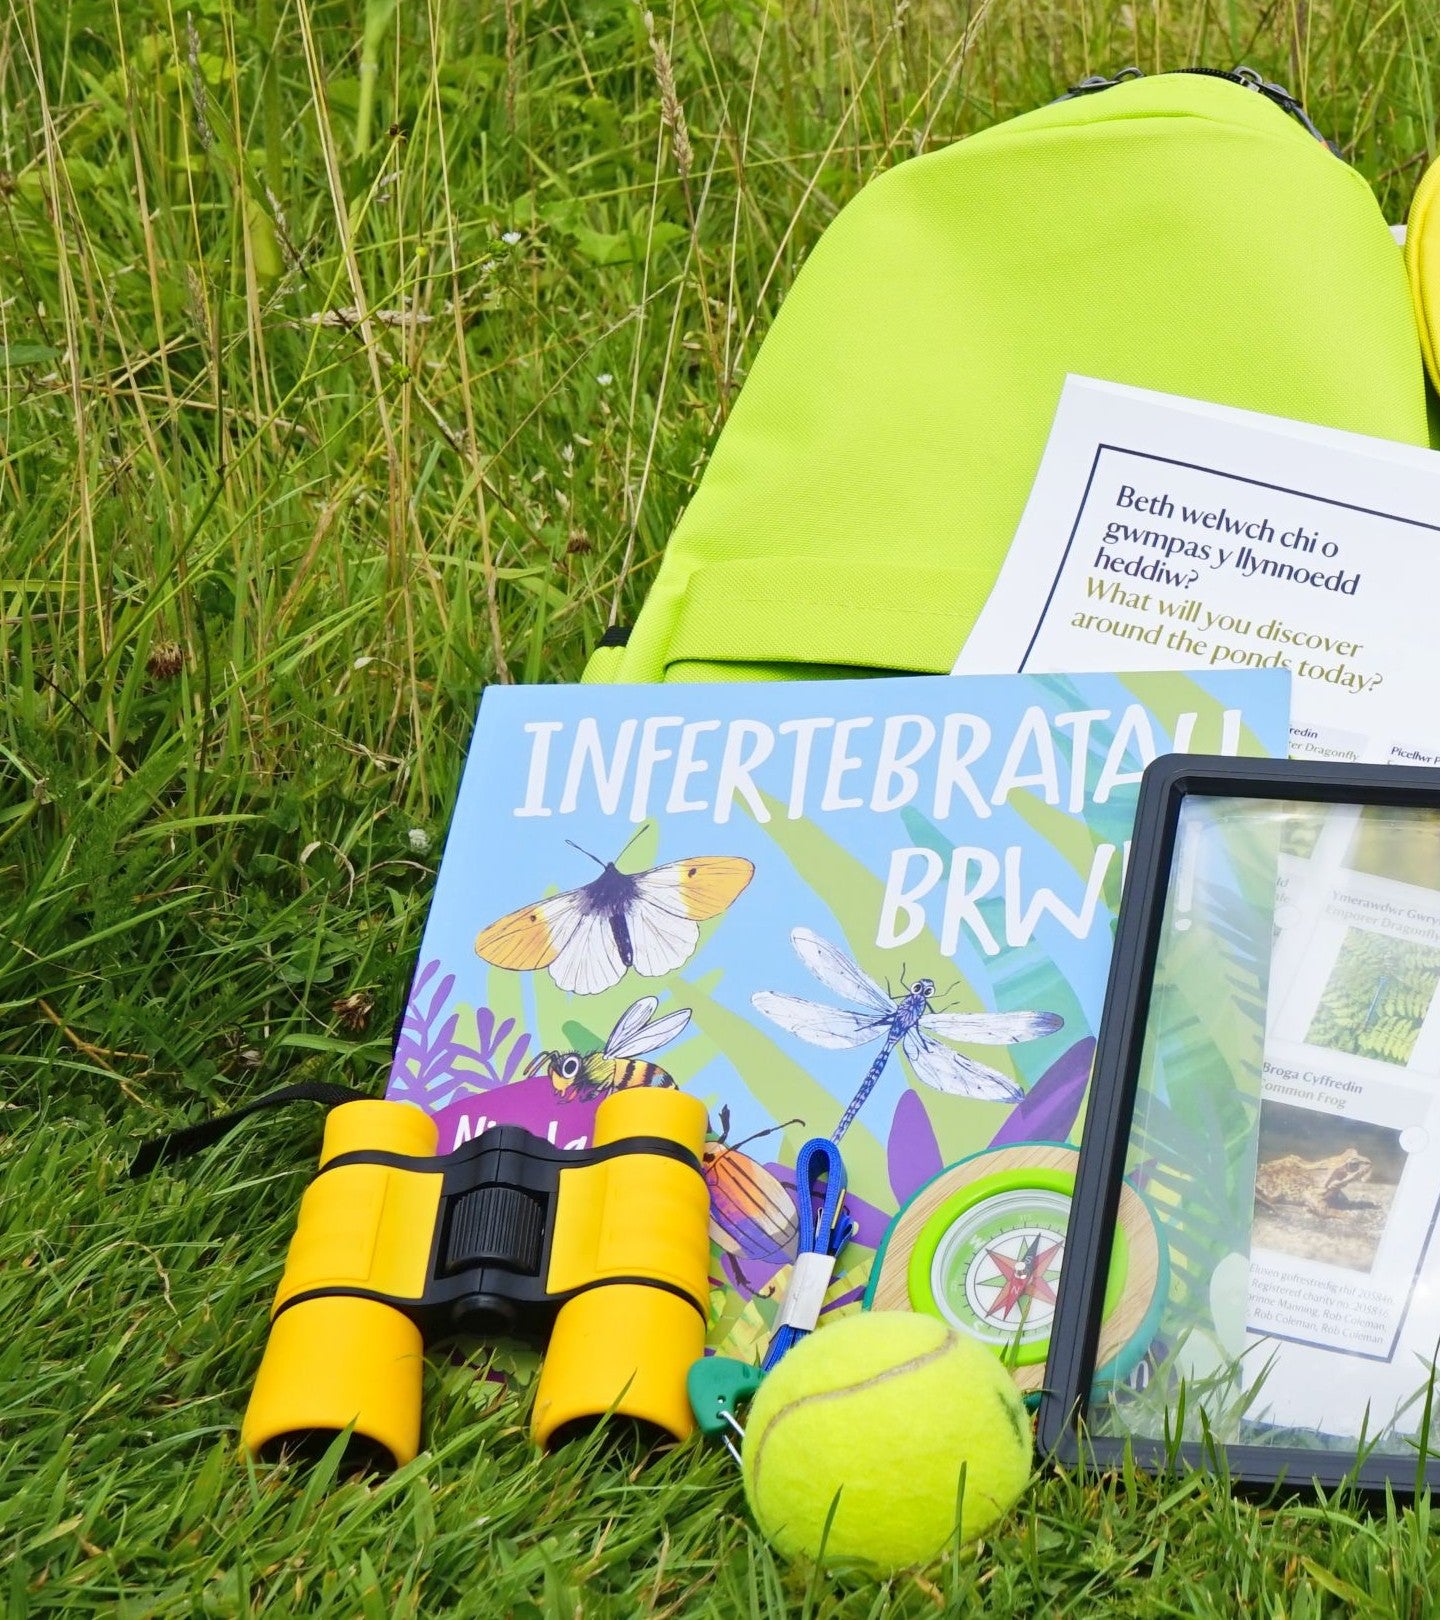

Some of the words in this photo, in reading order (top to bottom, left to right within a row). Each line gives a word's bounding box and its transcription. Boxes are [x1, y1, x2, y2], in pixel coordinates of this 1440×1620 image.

[1115, 485, 1175, 518] Beth
[1181, 505, 1276, 543] welwch
[1280, 527, 1320, 553] chi
[1321, 541, 1340, 559] o
[1093, 546, 1200, 591] heddiw?
[1102, 521, 1211, 560] gwmpas
[1211, 546, 1235, 570] y
[1235, 546, 1361, 597] llynnoedd
[1085, 576, 1153, 612] What
[1158, 594, 1203, 624] will
[1201, 611, 1252, 637] you
[1256, 618, 1364, 659] discover
[1070, 609, 1163, 647] around
[1166, 628, 1208, 657] the
[1211, 641, 1293, 669] ponds
[1297, 659, 1384, 694] today?
[1305, 743, 1359, 763] Dragonfly
[1391, 745, 1433, 763] Picellwr
[1380, 916, 1440, 943] Dragonfly
[1262, 1061, 1300, 1081] Broga
[1302, 1071, 1363, 1094] Cyffredin
[1261, 1079, 1314, 1099] ommon
[1316, 1091, 1347, 1110] Frog
[1251, 1278, 1301, 1298] Registered
